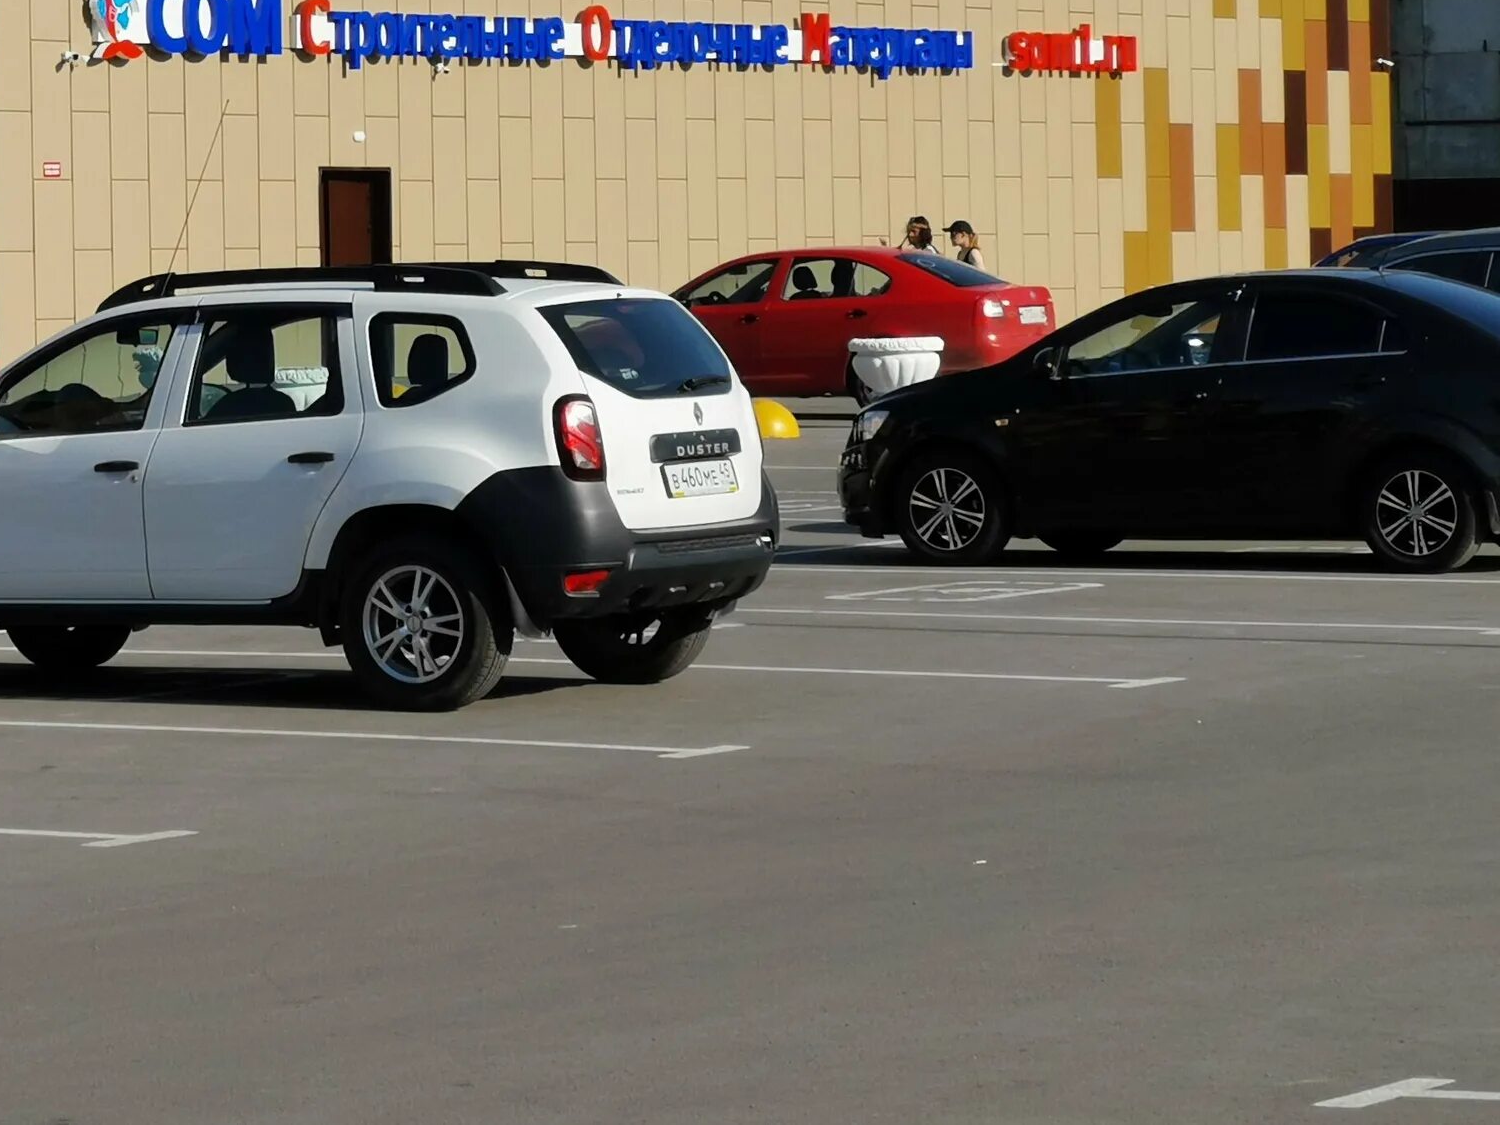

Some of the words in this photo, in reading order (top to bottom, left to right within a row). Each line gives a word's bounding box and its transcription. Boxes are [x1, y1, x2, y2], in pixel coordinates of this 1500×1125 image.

[581, 5, 789, 71] Отделочные
[801, 12, 973, 80] Материалы
[676, 442, 731, 457] DUSTER
